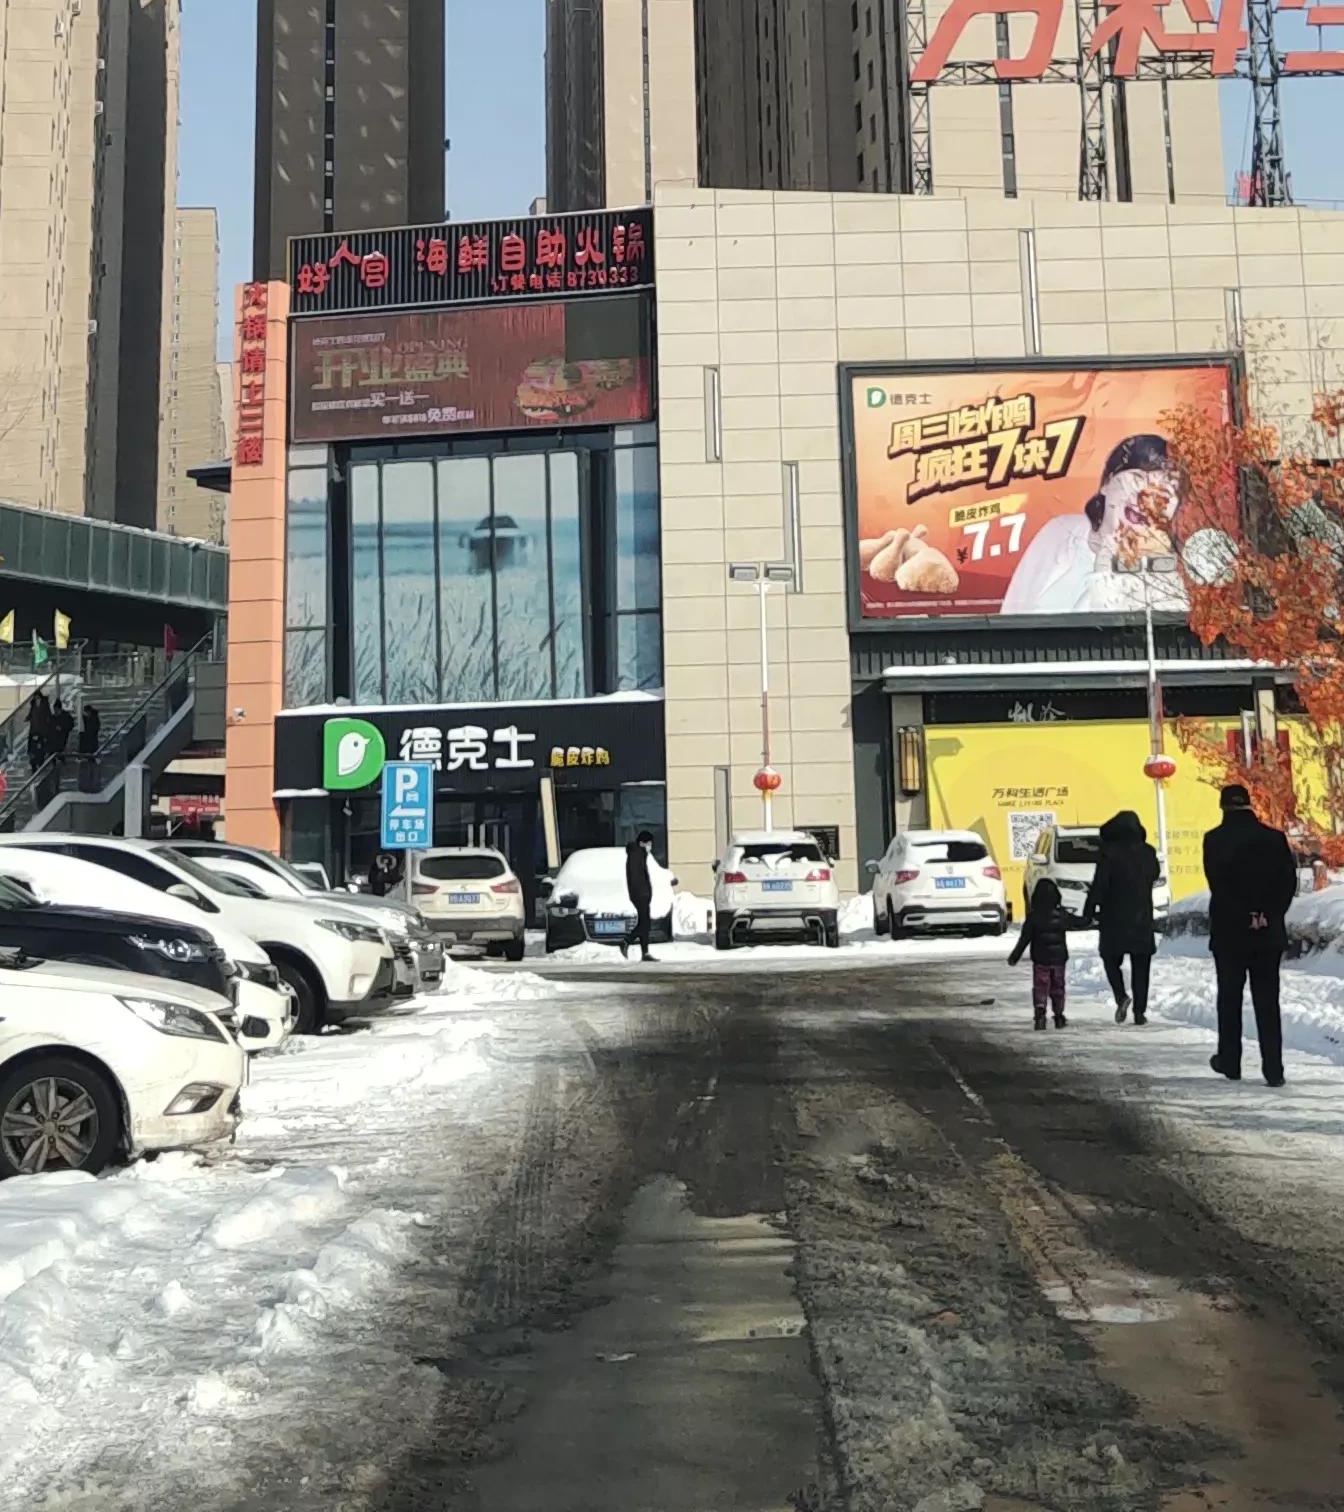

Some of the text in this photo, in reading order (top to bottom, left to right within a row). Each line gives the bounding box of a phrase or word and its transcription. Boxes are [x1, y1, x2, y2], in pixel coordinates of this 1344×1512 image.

[416, 222, 646, 276] 海鲜自助火锅
[889, 392, 932, 406] 德克士
[889, 393, 1033, 452] 周三吃炸鸡
[908, 416, 1080, 496] 疯狂7块7
[954, 502, 1002, 523] 脆皮炸鸡
[399, 725, 537, 771] 德克士
[396, 768, 419, 804] P
[389, 818, 425, 831] 停车场
[395, 831, 419, 843] 出口
